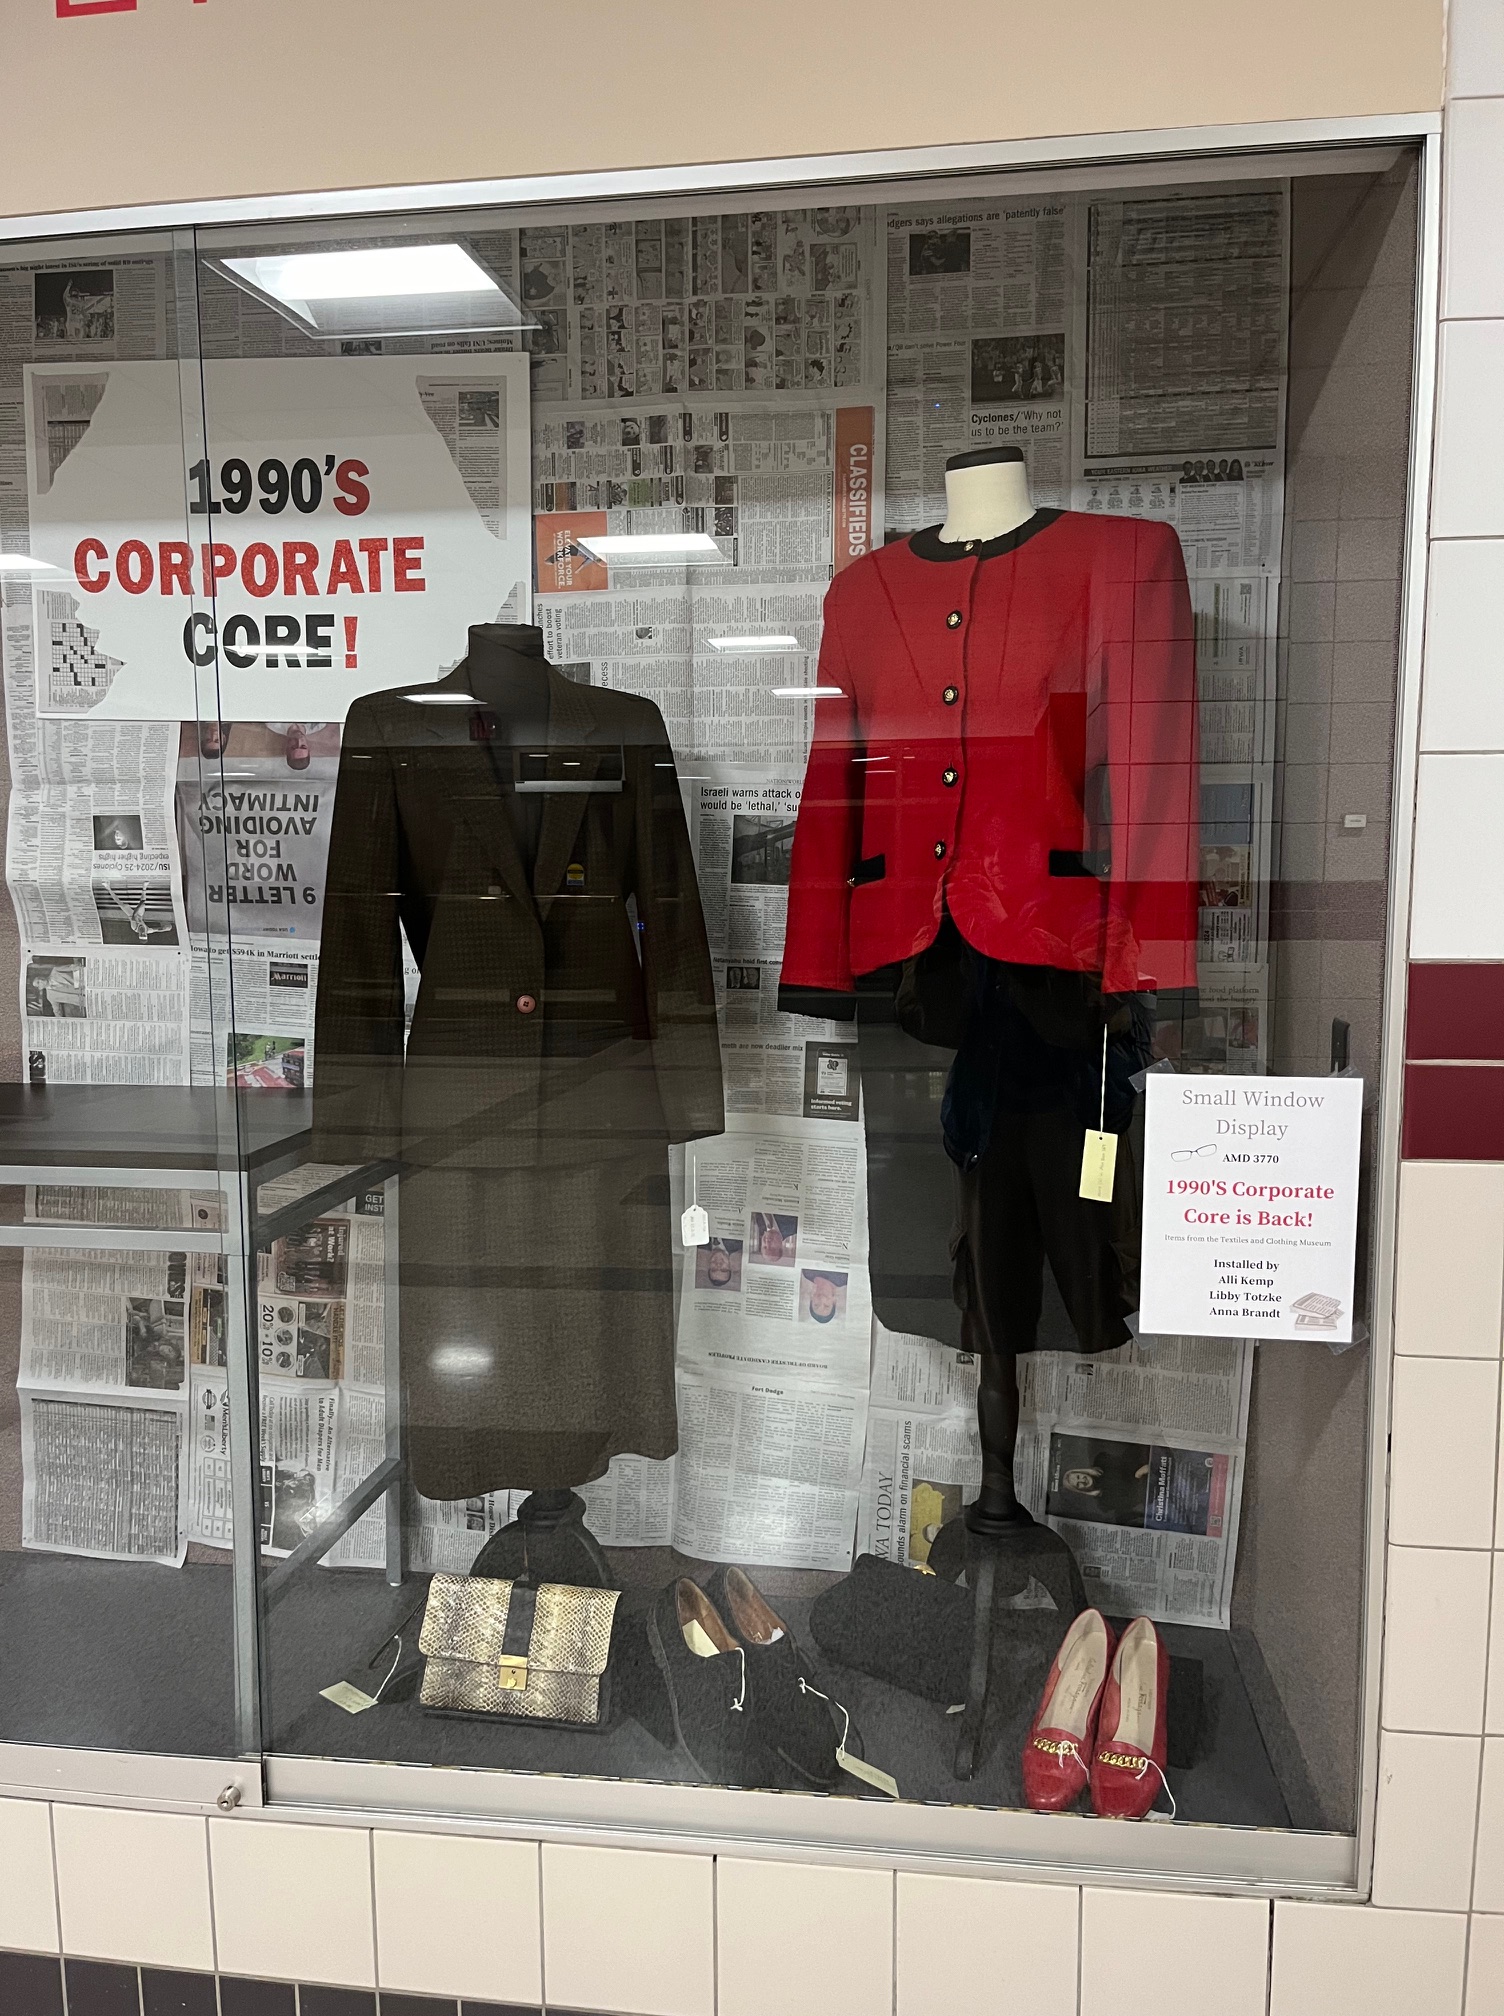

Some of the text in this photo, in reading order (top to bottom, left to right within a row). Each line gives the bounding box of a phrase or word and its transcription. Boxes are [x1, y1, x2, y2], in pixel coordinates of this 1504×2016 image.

[916, 217, 933, 227] says
[937, 213, 983, 225] allegations
[987, 212, 1000, 220] are
[1003, 208, 1040, 221] 'patently
[1043, 206, 1066, 216] false'
[1046, 409, 1061, 419] not
[971, 428, 982, 436] us
[986, 426, 994, 435] to
[998, 426, 1009, 435] be
[1013, 425, 1027, 434] the
[189, 455, 370, 516] 1990'S
[849, 444, 868, 556] CLASSIFIEDS
[74, 536, 425, 597] CORPORATE
[554, 609, 562, 630] voting
[183, 613, 358, 668] CORE!
[198, 792, 319, 812] INTIMACY
[701, 787, 728, 796] Israeli
[732, 789, 758, 797] warns
[762, 789, 791, 798] attack
[700, 801, 727, 810] would
[731, 801, 742, 810] be
[746, 801, 780, 812] 'lethal,'
[198, 816, 317, 835] AVOIDING
[99, 853, 116, 861] highs
[118, 853, 137, 861] higher
[235, 839, 280, 858] FOR
[93, 862, 170, 871] ISU/2024-25 Cyclones
[227, 863, 297, 882] WORD
[208, 885, 316, 905] 9 LETTER
[191, 945, 207, 953] Iowa
[258, 949, 264, 957] in
[266, 950, 298, 960] Marriott
[271, 972, 307, 982] Marriott
[766, 1043, 791, 1051] deadlier
[1183, 1089, 1325, 1108] Small Window
[1216, 1119, 1288, 1140] Display
[1222, 1154, 1279, 1164] AMD 3770
[366, 1194, 383, 1203] GET
[1166, 1180, 1334, 1201] 1990'S Corporate
[1184, 1208, 1313, 1227] Core is Back!
[327, 1226, 335, 1262] at Work?
[337, 1226, 346, 1256] Injured
[1165, 1234, 1185, 1242] Items
[1220, 1236, 1248, 1244] Textiles
[1266, 1238, 1297, 1246] Clothing
[1214, 1259, 1279, 1271] Installed by
[1218, 1275, 1274, 1287] Alli Kemp
[1210, 1291, 1282, 1303] Libby Totzke
[1210, 1307, 1281, 1319] Anna Brandt
[736, 1355, 770, 1364] CANDIDATE
[327, 1426, 333, 1435] An
[903, 1421, 911, 1450] scams
[325, 1436, 333, 1471] Alternative
[899, 1453, 909, 1490] financial
[1155, 1456, 1167, 1521] Christina Moffatt
[876, 1471, 892, 1531] TODAY
[901, 1494, 907, 1504] on
[897, 1508, 907, 1533] alarm
